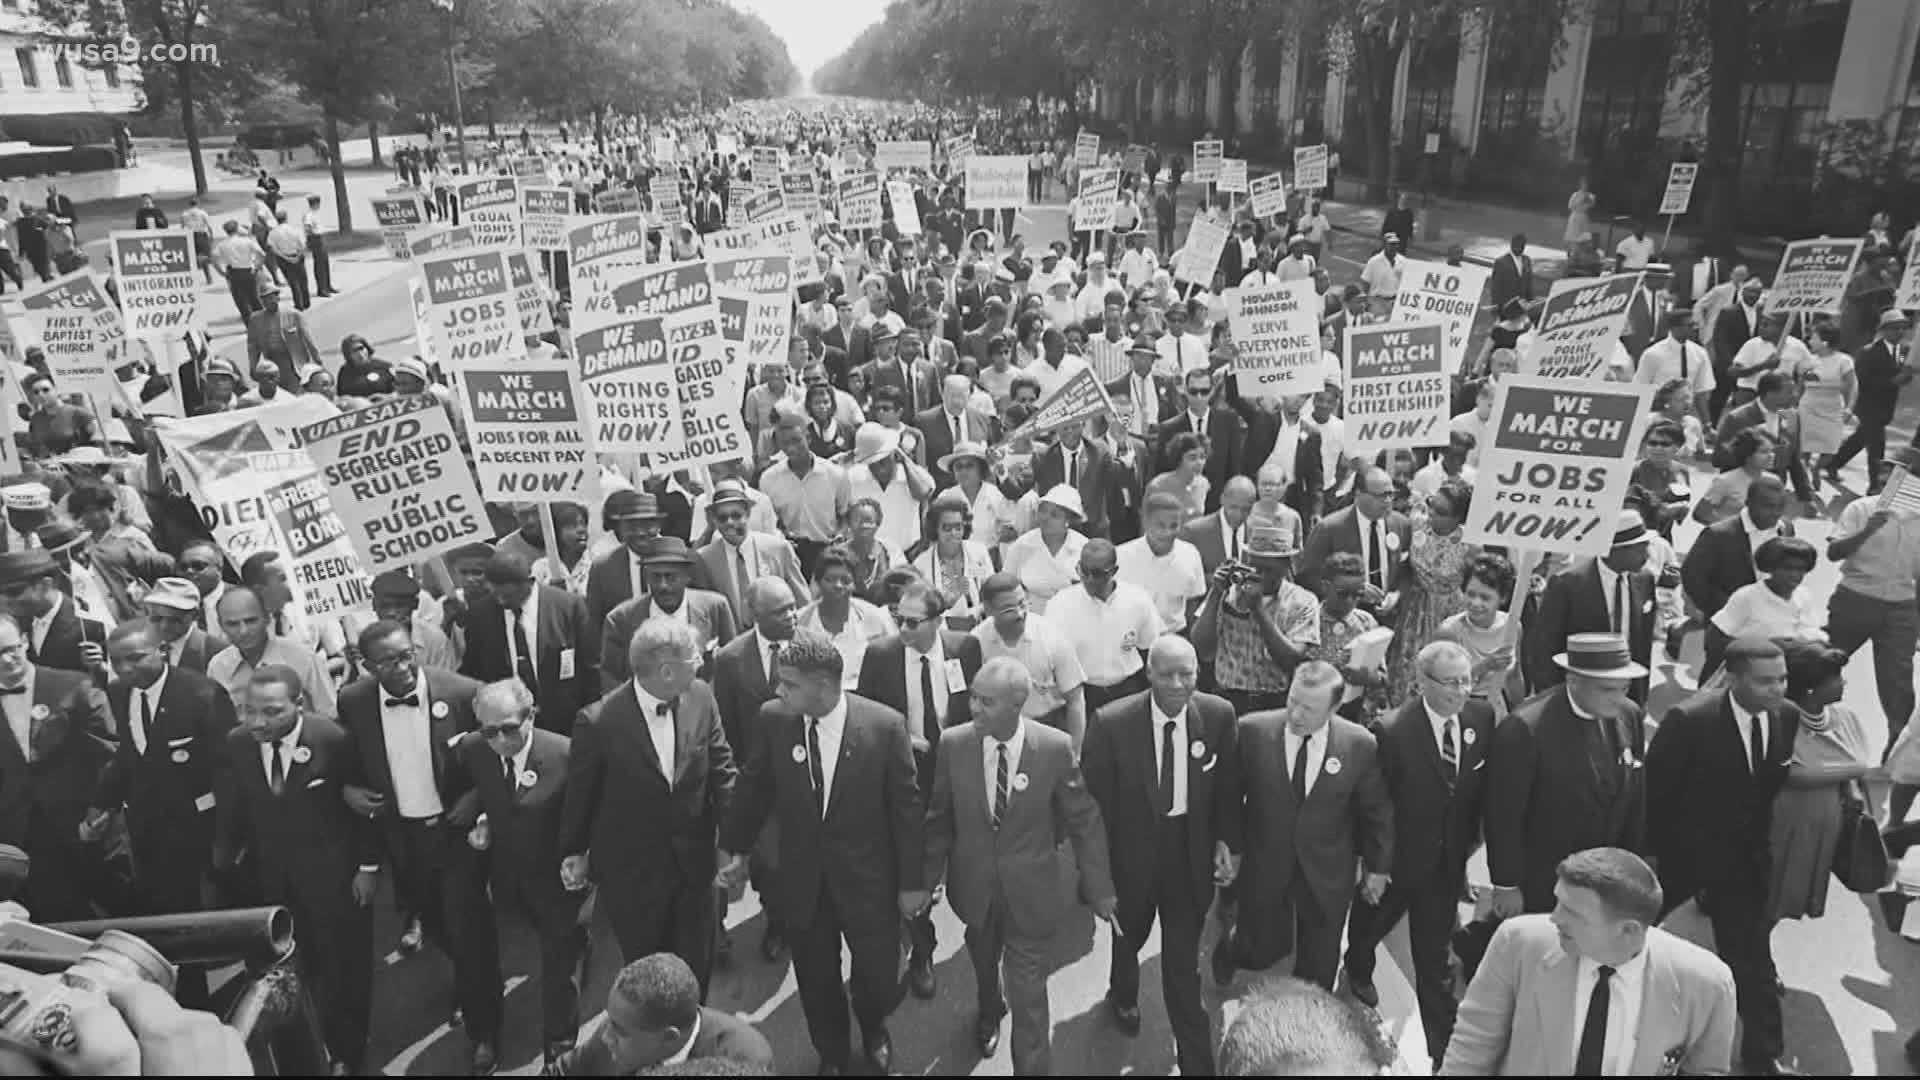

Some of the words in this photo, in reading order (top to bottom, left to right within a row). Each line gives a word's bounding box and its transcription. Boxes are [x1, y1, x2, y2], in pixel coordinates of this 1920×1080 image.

[470, 213, 513, 223] EQUAL
[591, 221, 617, 240] WE
[140, 239, 163, 250] WE
[576, 231, 639, 261] DEMAND
[124, 251, 185, 266] MARCH
[452, 258, 477, 273] WE
[733, 259, 765, 277] WE
[1789, 255, 1849, 267] MARCH
[143, 265, 168, 273] FOR
[435, 268, 500, 294] MARCH
[644, 271, 678, 300] WE
[1424, 271, 1461, 292] NO
[127, 293, 196, 309] SCHOOLS
[624, 283, 709, 316] DEMAND
[1241, 291, 1292, 305] HOWARD
[1574, 284, 1611, 306] WE
[1776, 297, 1833, 308] NOW!
[443, 300, 506, 328] JOBS
[1240, 301, 1298, 317] JOHNSON
[1424, 297, 1475, 317] DOUGH
[1546, 292, 1628, 329] DEMAND
[47, 316, 85, 329] FIRST
[136, 308, 195, 329] NOW!
[1252, 320, 1289, 335] SERVE
[43, 329, 93, 341] BAPTIST
[603, 325, 634, 348] WE
[1239, 335, 1312, 352] EVERYONE
[1382, 331, 1411, 346] WE
[1546, 331, 1573, 342] AN
[1576, 327, 1609, 340] END
[48, 342, 95, 355] CHURCH
[451, 332, 514, 360] NOW!
[1358, 343, 1435, 367] MARCH
[584, 340, 664, 375] DEMAND
[1233, 351, 1314, 369] EVERYWHERE
[1259, 371, 1295, 384] CORE
[1381, 365, 1412, 374] FOR
[1537, 358, 1602, 378] NOW!
[499, 375, 534, 389] WE
[589, 382, 670, 399] VOTING
[1352, 383, 1392, 398] FIRST
[1398, 378, 1443, 394] CLASS
[477, 391, 566, 409] MARCH
[1348, 395, 1445, 415] CITIZENSHIP
[1552, 395, 1593, 415] WE
[507, 411, 542, 421] FOR
[597, 403, 669, 419] RIGHTS
[308, 412, 358, 440] UAW
[599, 420, 671, 442] NOW!
[1358, 415, 1437, 441] NOW!
[1509, 412, 1624, 441] MARCH
[338, 418, 422, 458] END
[477, 431, 515, 444] JOBS
[518, 431, 550, 444] FOR
[554, 430, 585, 443] ALL
[1539, 440, 1583, 452] FOR
[324, 432, 453, 487] SEGREGATED
[480, 452, 492, 463] A
[494, 451, 551, 463] DECENT
[555, 450, 586, 463] PAY
[351, 459, 444, 501] RULES
[498, 469, 585, 492] NOW!
[1497, 461, 1608, 493] JOBS
[391, 493, 421, 511] IN
[1495, 491, 1541, 504] FOR
[1555, 497, 1596, 510] ALL
[363, 494, 466, 540] PUBLIC
[1484, 511, 1600, 542] NOW!
[369, 514, 479, 564] SCHOOLS
[336, 577, 374, 607] LIVE
